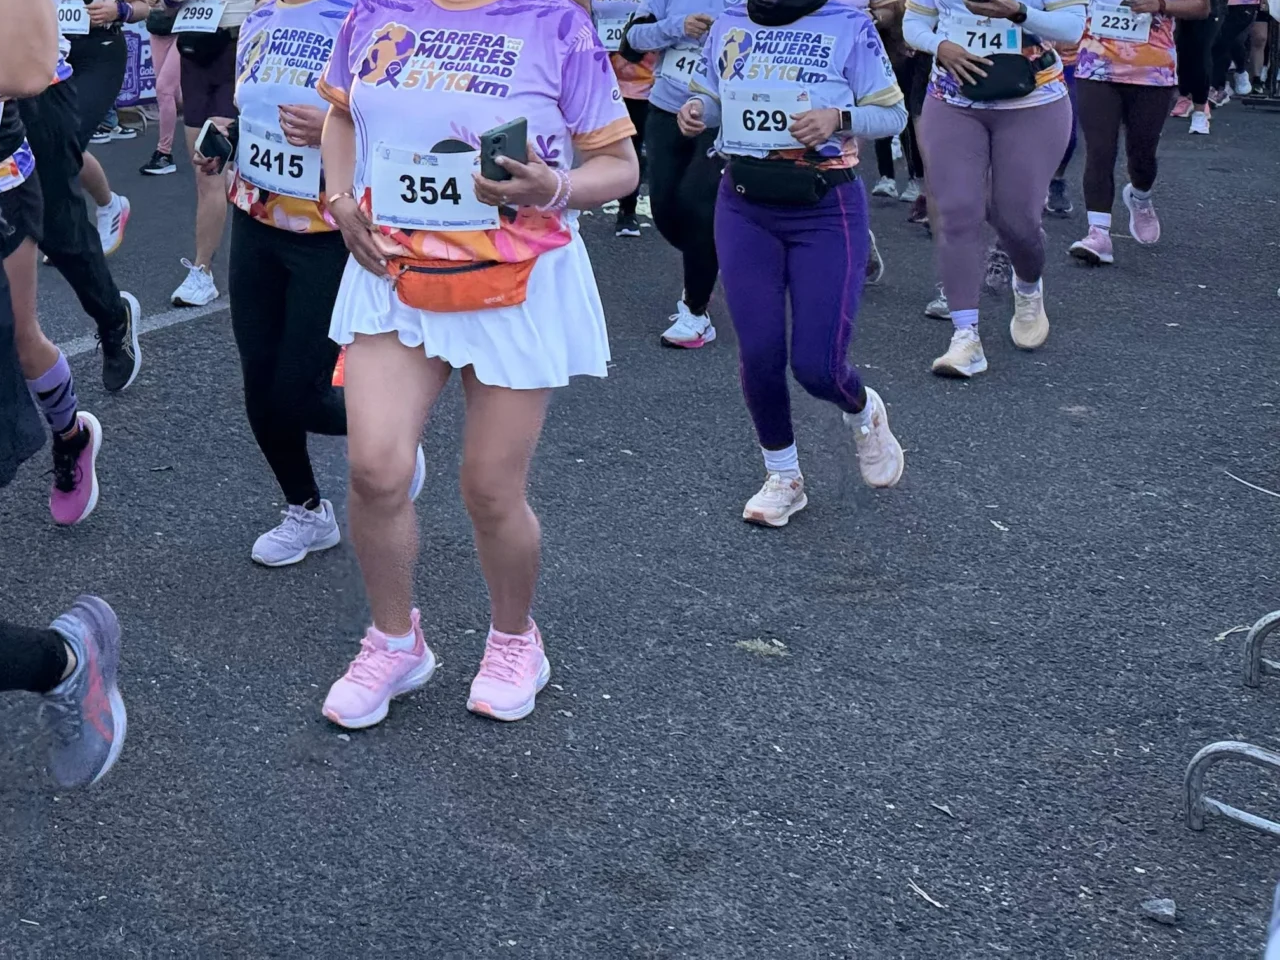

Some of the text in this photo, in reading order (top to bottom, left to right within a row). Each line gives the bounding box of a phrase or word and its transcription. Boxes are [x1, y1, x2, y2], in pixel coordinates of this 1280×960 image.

[182, 6, 214, 21] 2999
[1101, 15, 1138, 32] 2237
[272, 28, 334, 50] CARRERA
[420, 30, 506, 48] CARRERA
[755, 30, 822, 44] CARRERA
[966, 31, 1002, 49] 714
[268, 41, 332, 62] MUJERE
[413, 43, 518, 66] MUJERES
[752, 41, 832, 59] MUJERES
[284, 58, 324, 72] IGUALD
[410, 60, 513, 78] Y LA IGUALDAD
[772, 56, 828, 68] IGUALDAD
[260, 66, 320, 88] 5 Y 10k
[747, 64, 828, 84] 5 Y 10km
[402, 70, 510, 98] 5 Y 10km
[742, 110, 788, 132] 629
[250, 143, 304, 178] 2415
[400, 174, 462, 206] 354
